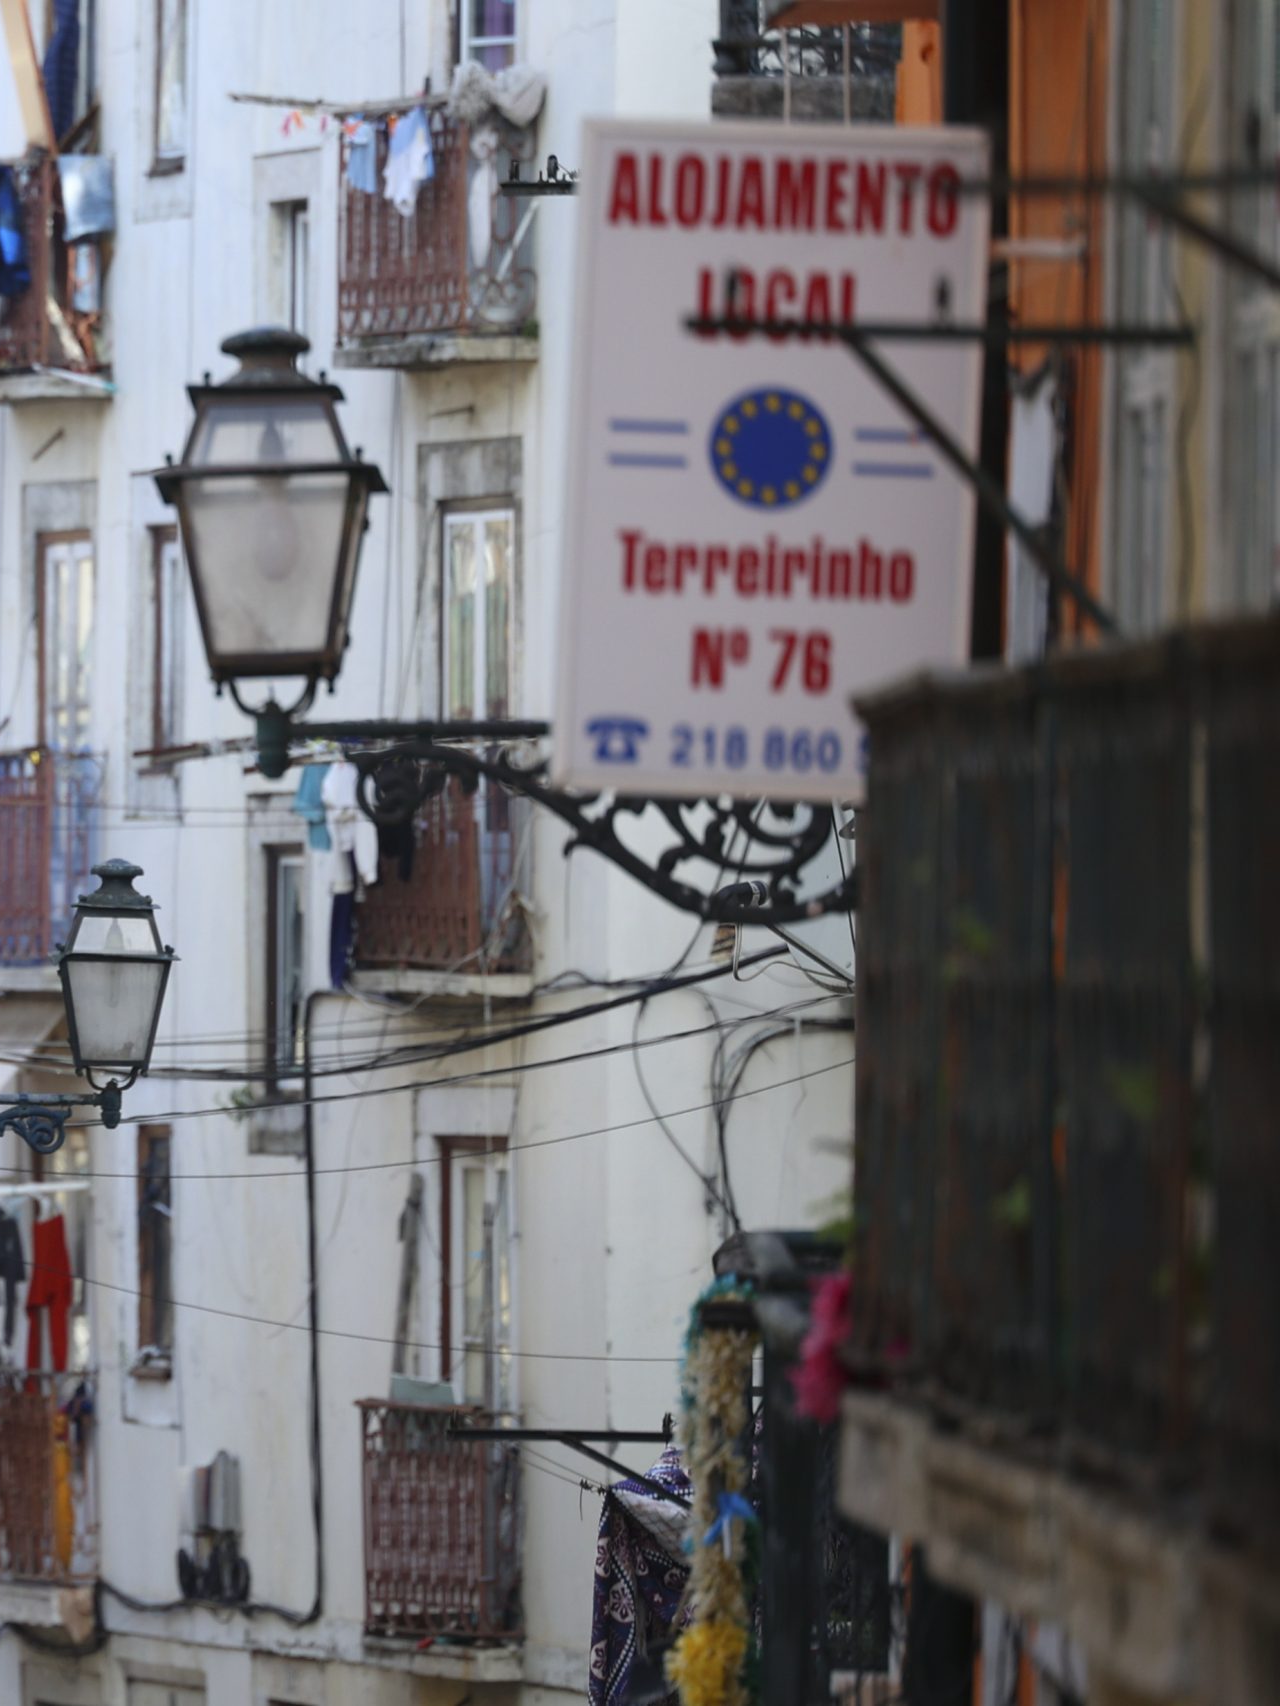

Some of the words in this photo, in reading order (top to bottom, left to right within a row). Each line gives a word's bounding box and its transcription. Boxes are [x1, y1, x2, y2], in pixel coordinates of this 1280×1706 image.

[607, 151, 962, 239] ALOJAMENTO
[696, 264, 857, 345] LOCAL
[618, 529, 917, 604] Terreirinho
[768, 629, 833, 694] 76
[671, 724, 748, 770] 218
[763, 729, 842, 774] 860
